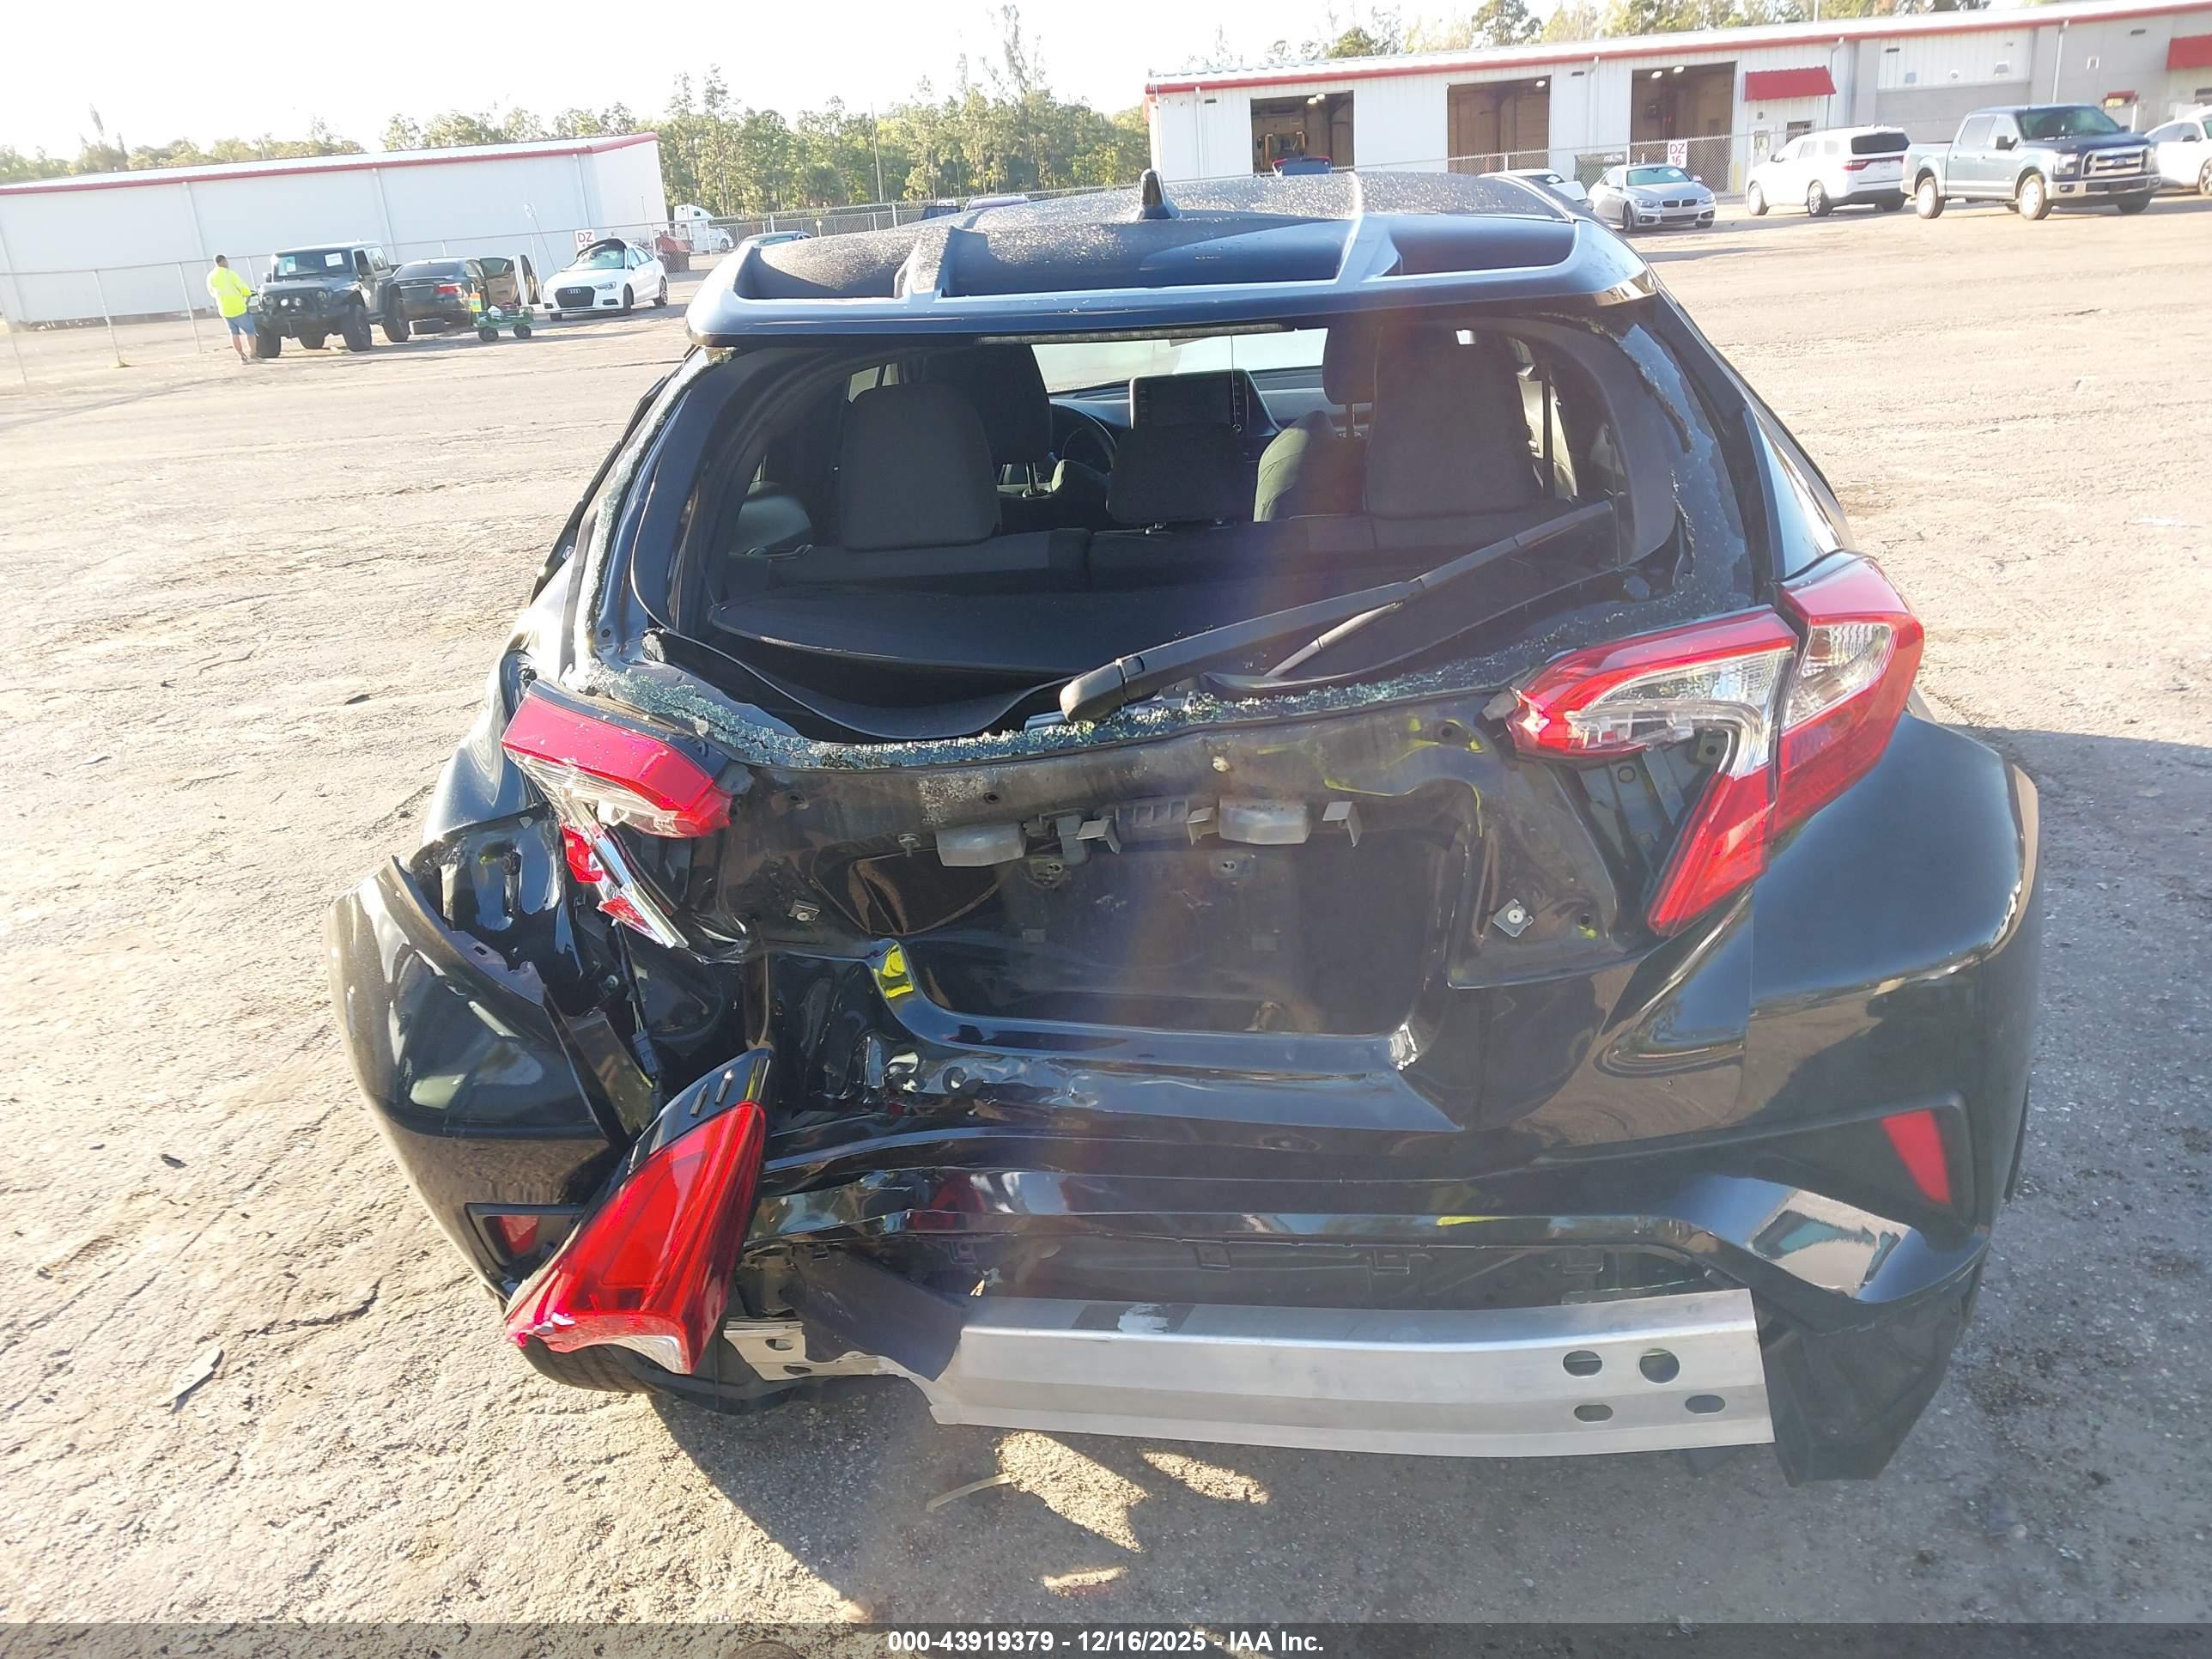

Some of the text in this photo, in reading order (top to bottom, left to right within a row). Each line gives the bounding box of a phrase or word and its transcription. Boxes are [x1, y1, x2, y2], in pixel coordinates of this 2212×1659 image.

[1669, 143, 1686, 155] DZ
[1671, 155, 1682, 166] 16
[577, 232, 593, 242] DZ
